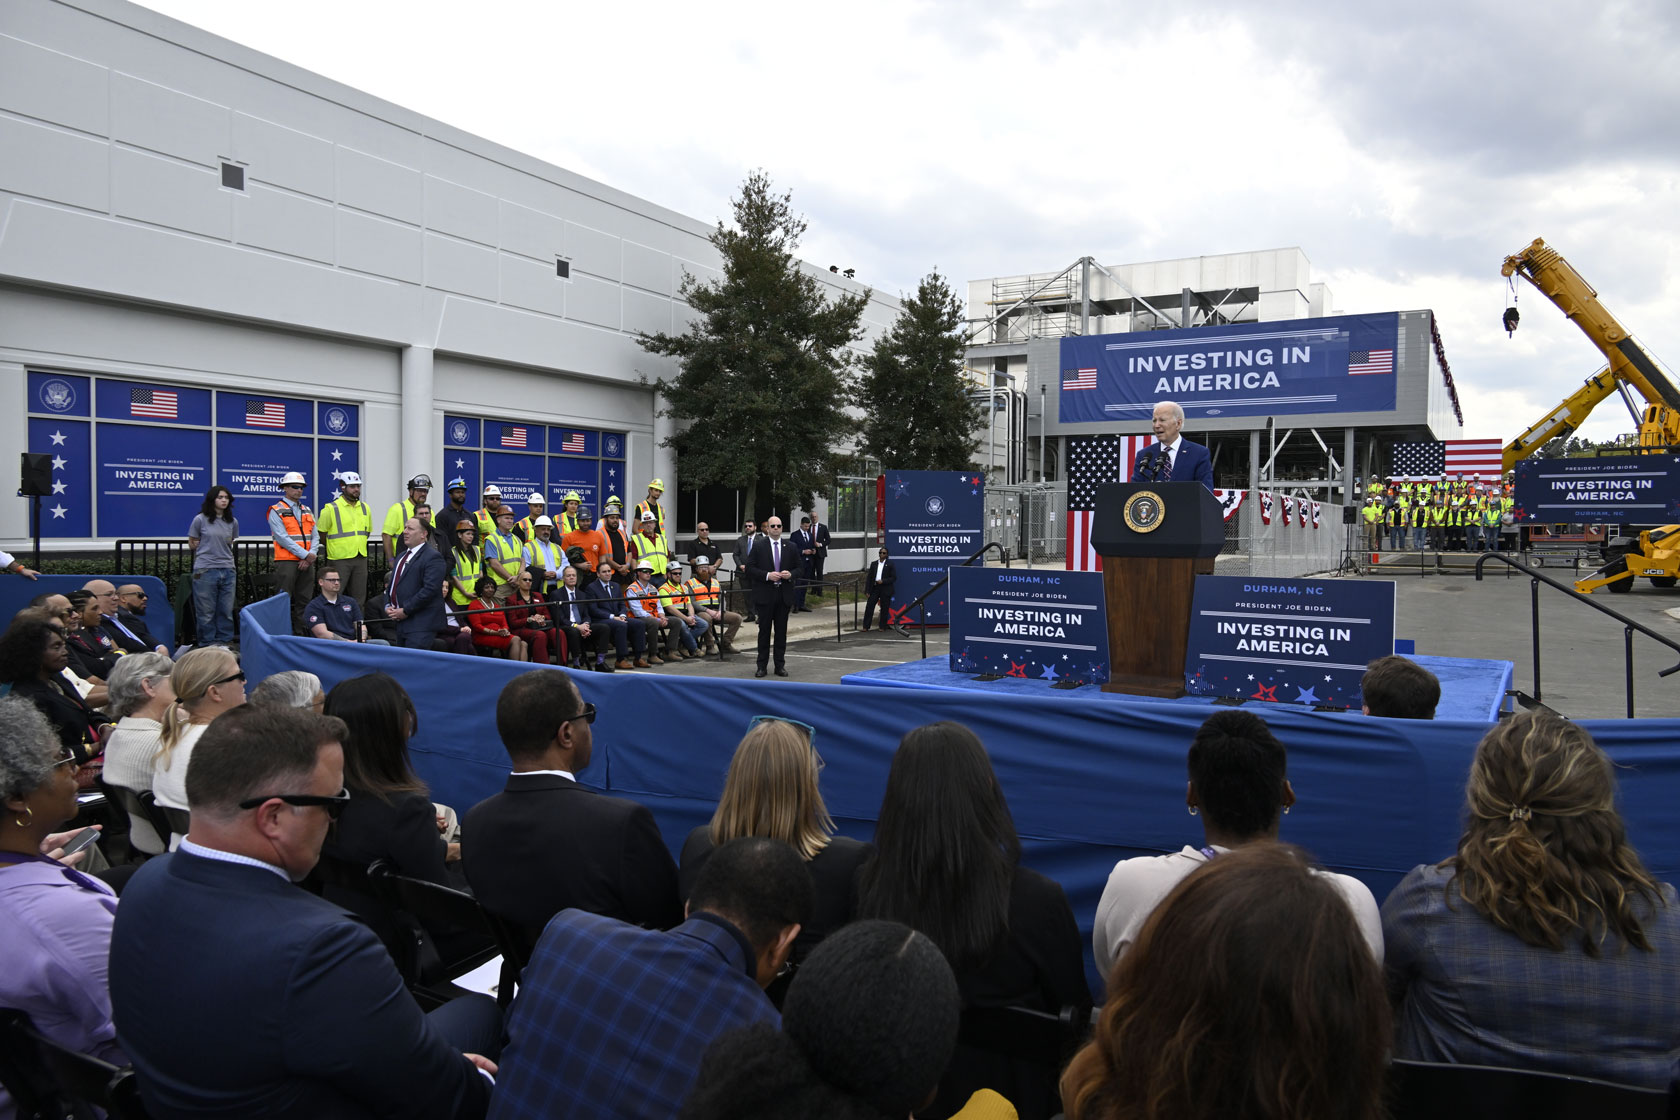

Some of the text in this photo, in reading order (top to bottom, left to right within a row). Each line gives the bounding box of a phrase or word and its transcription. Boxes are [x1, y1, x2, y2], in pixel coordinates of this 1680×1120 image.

[1128, 346, 1310, 373] INVESTING IN
[1154, 371, 1280, 394] AMERICA
[115, 470, 179, 480] INVESTING
[128, 480, 183, 489] AMERICA
[1551, 480, 1652, 490] INVESTING IN
[1566, 491, 1635, 500] AMERICA
[898, 536, 971, 544] INVESTING IN
[909, 545, 960, 553] AMERICA
[998, 575, 1044, 584] DURHAM,
[1244, 584, 1324, 595] DURHAM, NC
[978, 608, 1082, 625] INVESTING IN
[994, 622, 1066, 638] AMERICA
[1217, 622, 1351, 642] INVESTING IN
[1236, 638, 1329, 656] AMERICA
